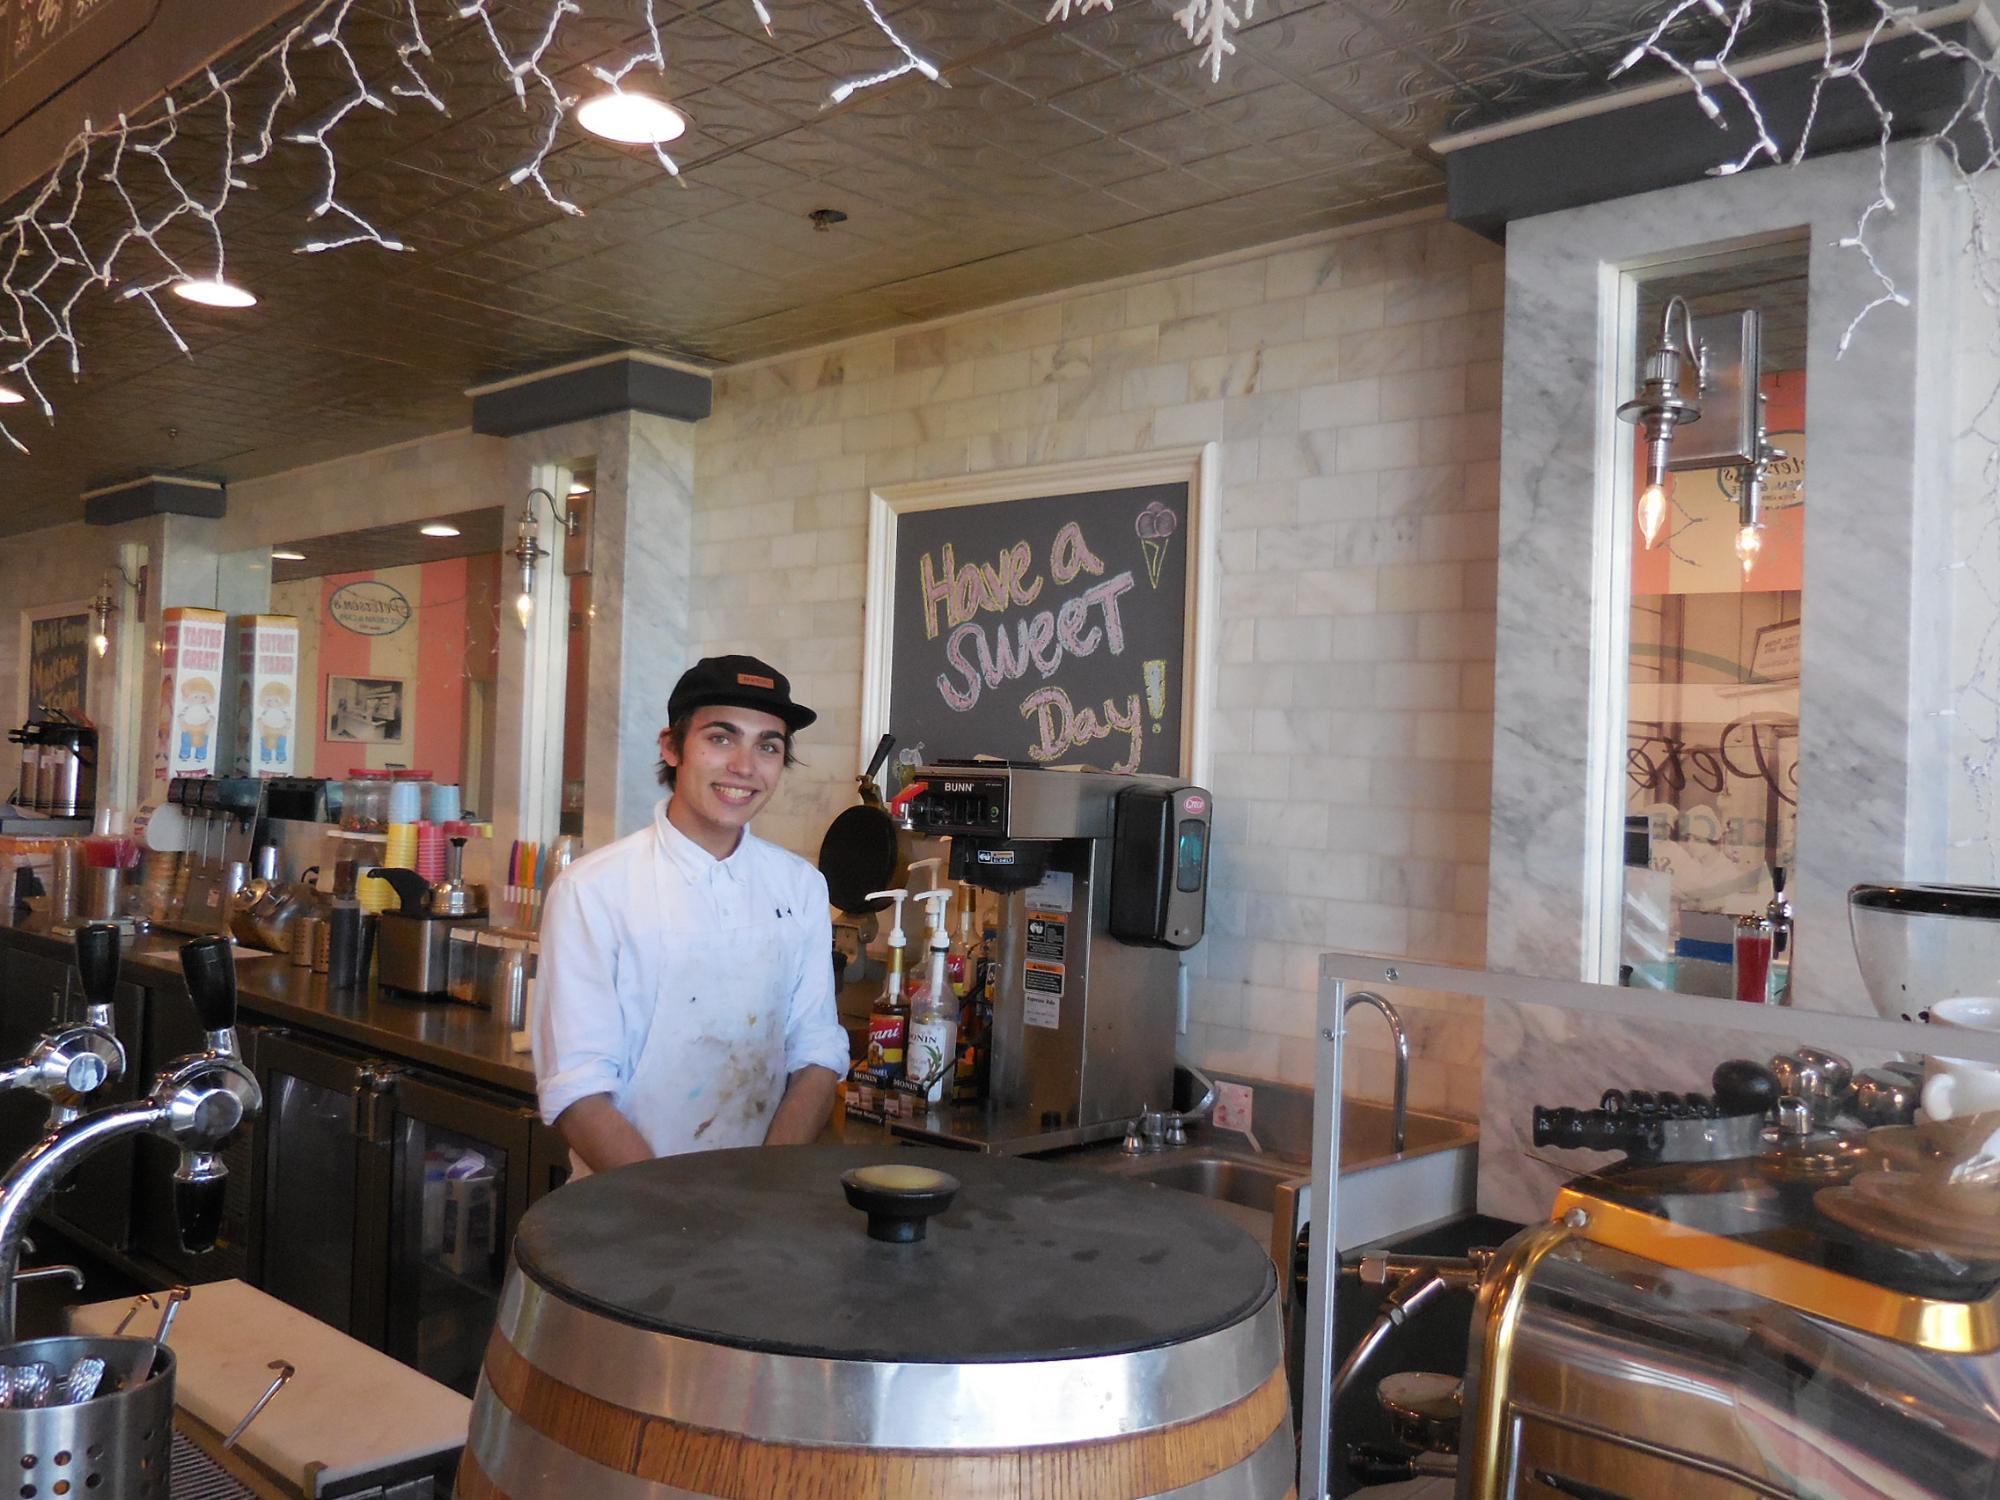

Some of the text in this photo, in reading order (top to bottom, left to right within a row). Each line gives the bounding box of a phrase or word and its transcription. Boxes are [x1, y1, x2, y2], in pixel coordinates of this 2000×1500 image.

[920, 520, 1105, 640] Have a
[1018, 659, 1168, 776] Day!
[944, 782, 973, 792] BUNN
[910, 1032, 937, 1044] ONIN
[853, 1071, 878, 1083] MONIN
[893, 1078, 919, 1091] MONIN
